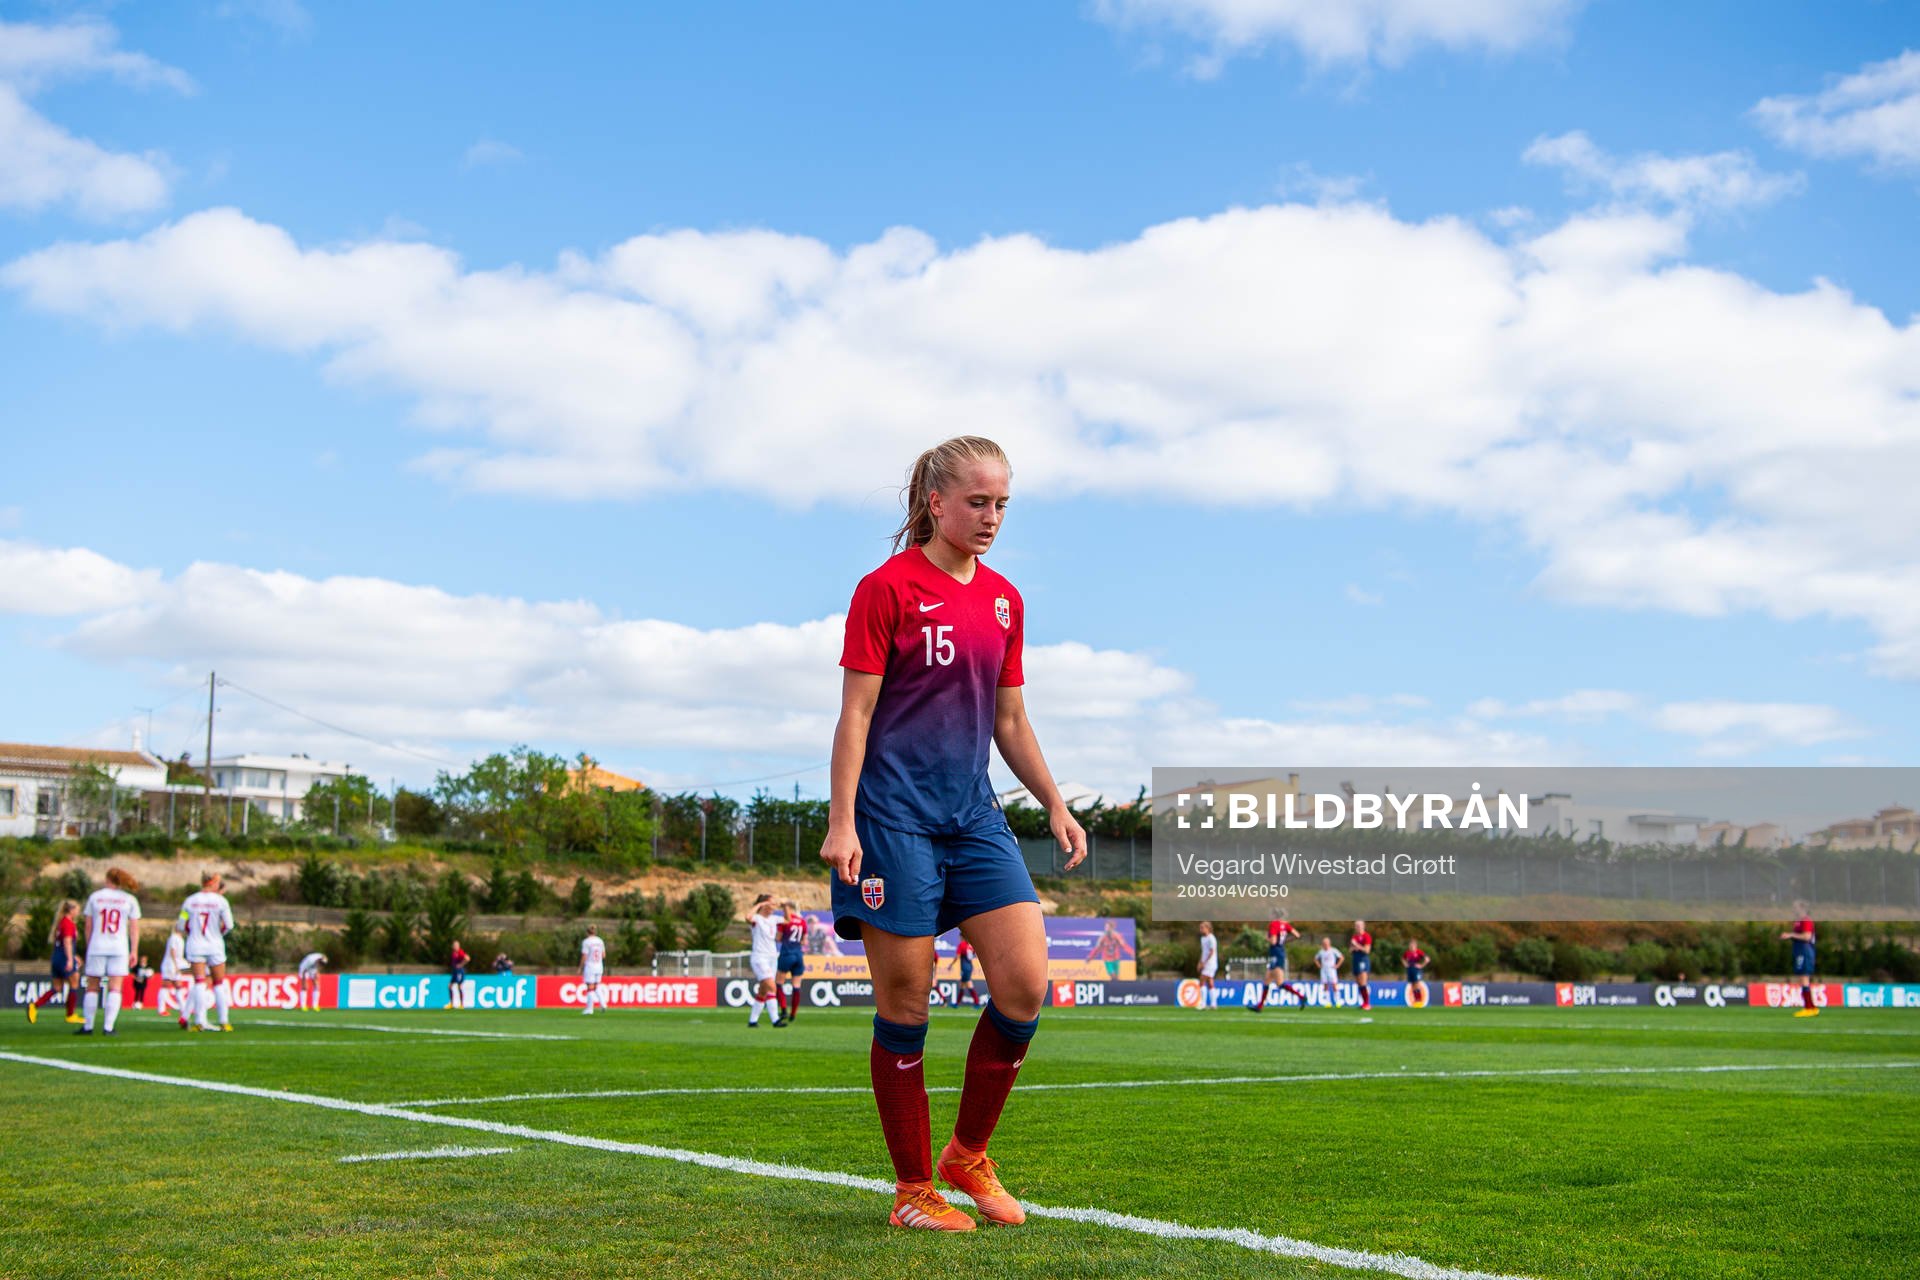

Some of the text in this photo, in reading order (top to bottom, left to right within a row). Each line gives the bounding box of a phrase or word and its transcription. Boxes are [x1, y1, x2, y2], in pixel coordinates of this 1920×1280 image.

[921, 625, 956, 667] 15
[99, 908, 121, 934] 19
[199, 912, 211, 936] 7
[789, 924, 803, 943] 21
[824, 961, 867, 975] Algarve
[378, 977, 431, 1009] cuf
[478, 978, 528, 1009] cuf
[836, 982, 874, 996] altice
[1075, 983, 1105, 1005] BPI
[1461, 985, 1486, 1005] BPI
[1573, 985, 1596, 1005] BPI
